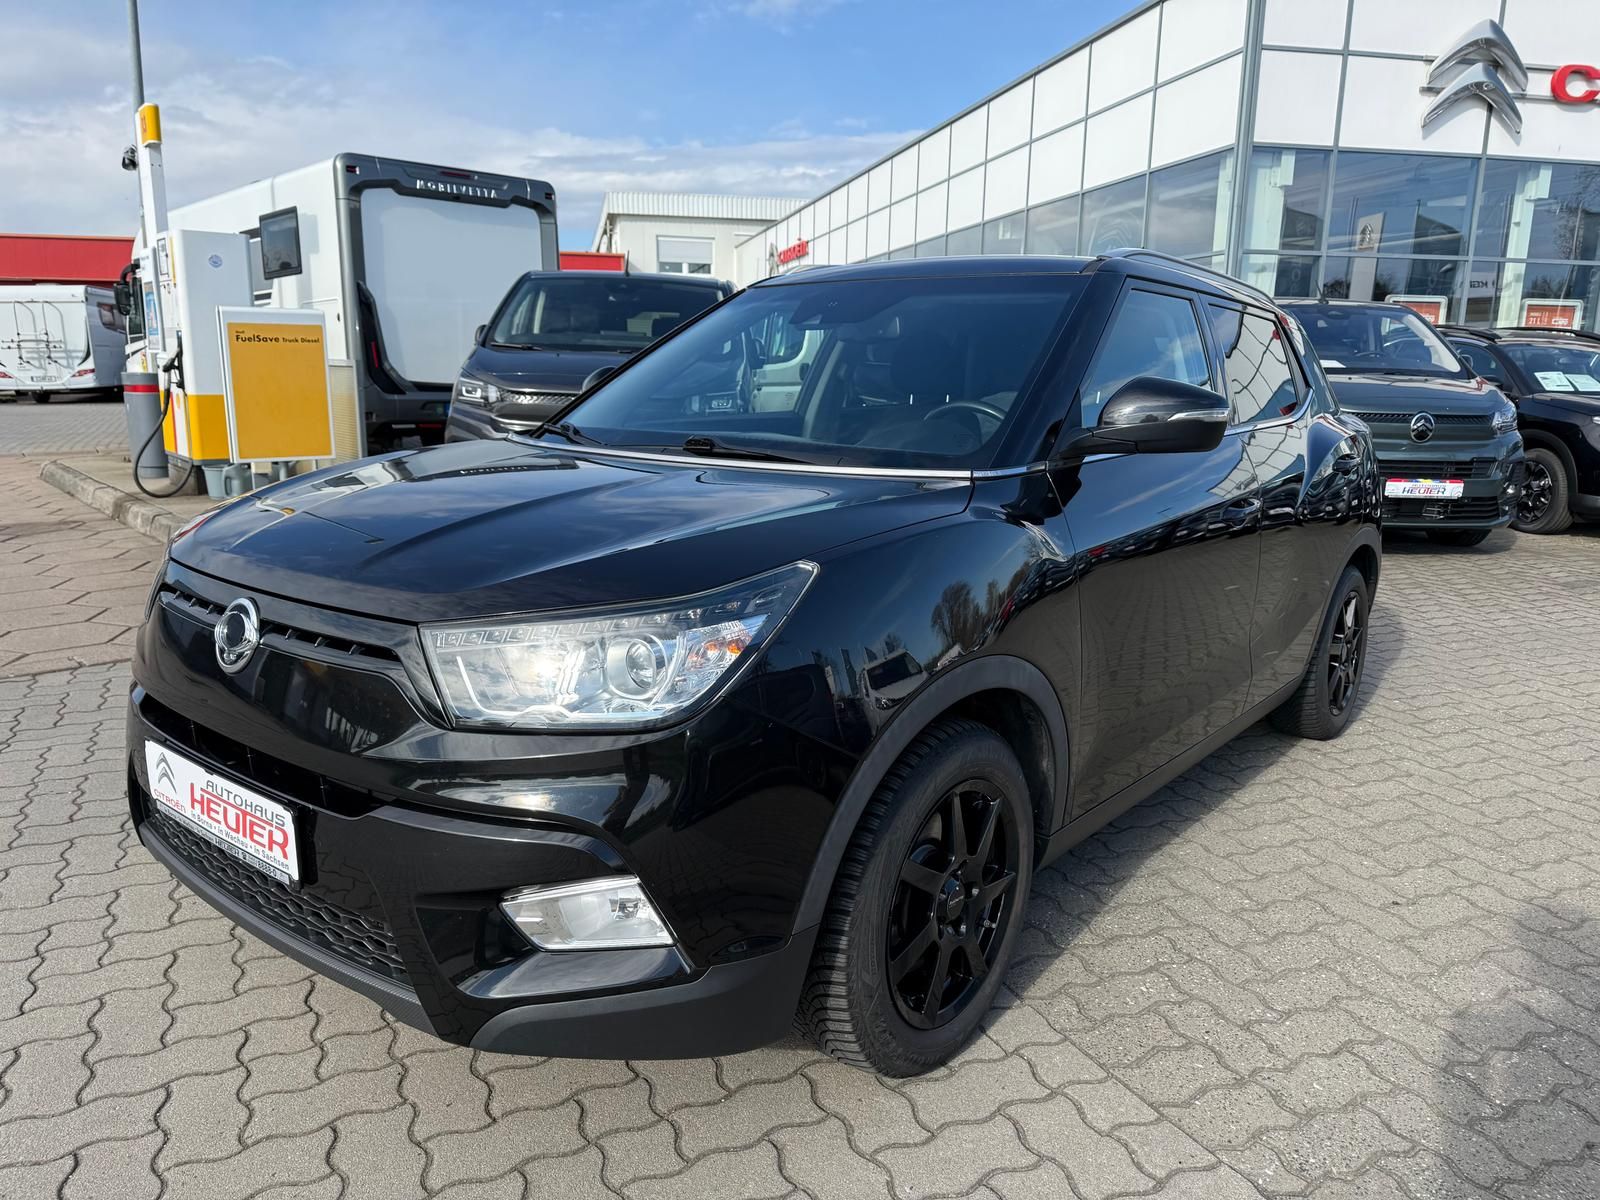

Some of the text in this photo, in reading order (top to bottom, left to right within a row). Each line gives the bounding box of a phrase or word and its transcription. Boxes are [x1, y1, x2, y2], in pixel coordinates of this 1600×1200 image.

[416, 179, 498, 199] MOBILVETTA
[235, 334, 280, 343] FuelSave
[206, 780, 286, 828] AUTOHAUS
[190, 782, 289, 861] HEUTER
[261, 849, 290, 871] Sachsen
